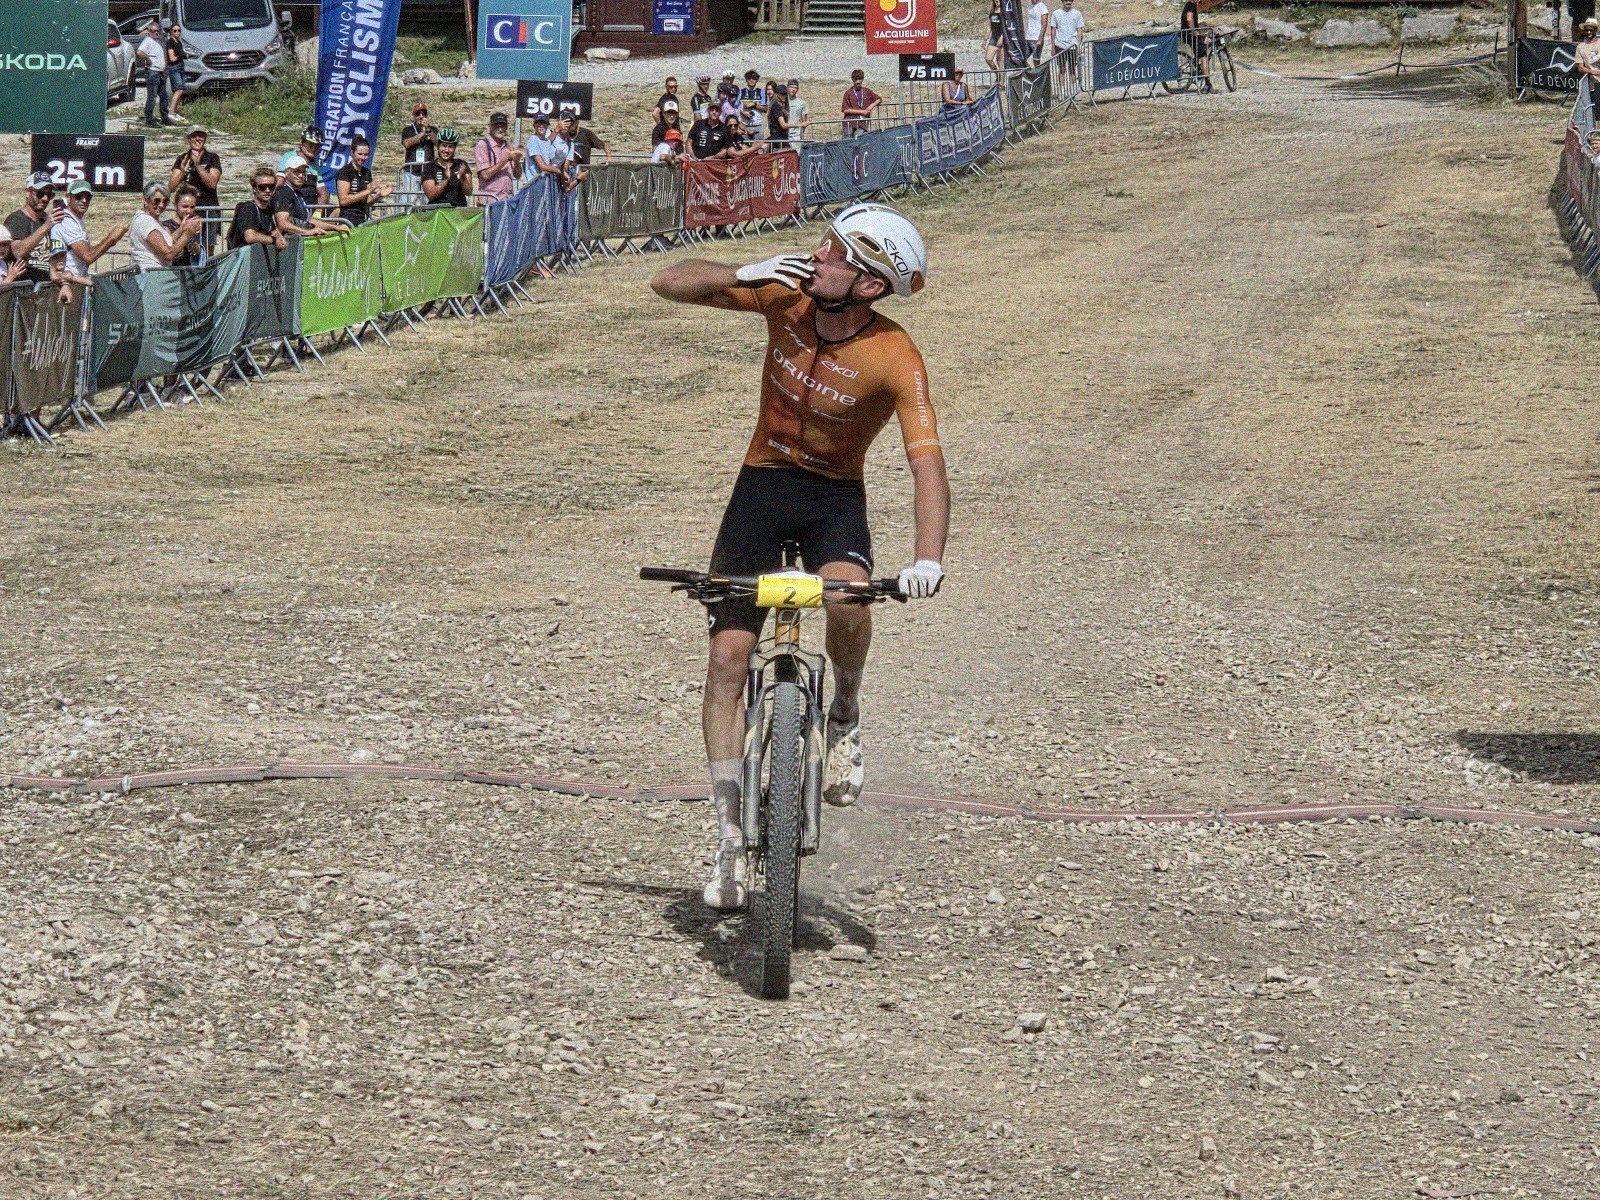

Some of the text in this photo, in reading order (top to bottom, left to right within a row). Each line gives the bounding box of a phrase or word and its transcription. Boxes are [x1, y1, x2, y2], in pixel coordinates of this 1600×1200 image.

[493, 20, 553, 44] CIC
[873, 29, 930, 39] JACQUELINE
[0, 53, 88, 71] KODA
[907, 65, 947, 79] 75 m
[1105, 72, 1115, 84] LE
[1533, 74, 1544, 86] LE
[526, 97, 554, 115] 50
[46, 160, 126, 186] 25 m
[783, 586, 797, 605] 2
